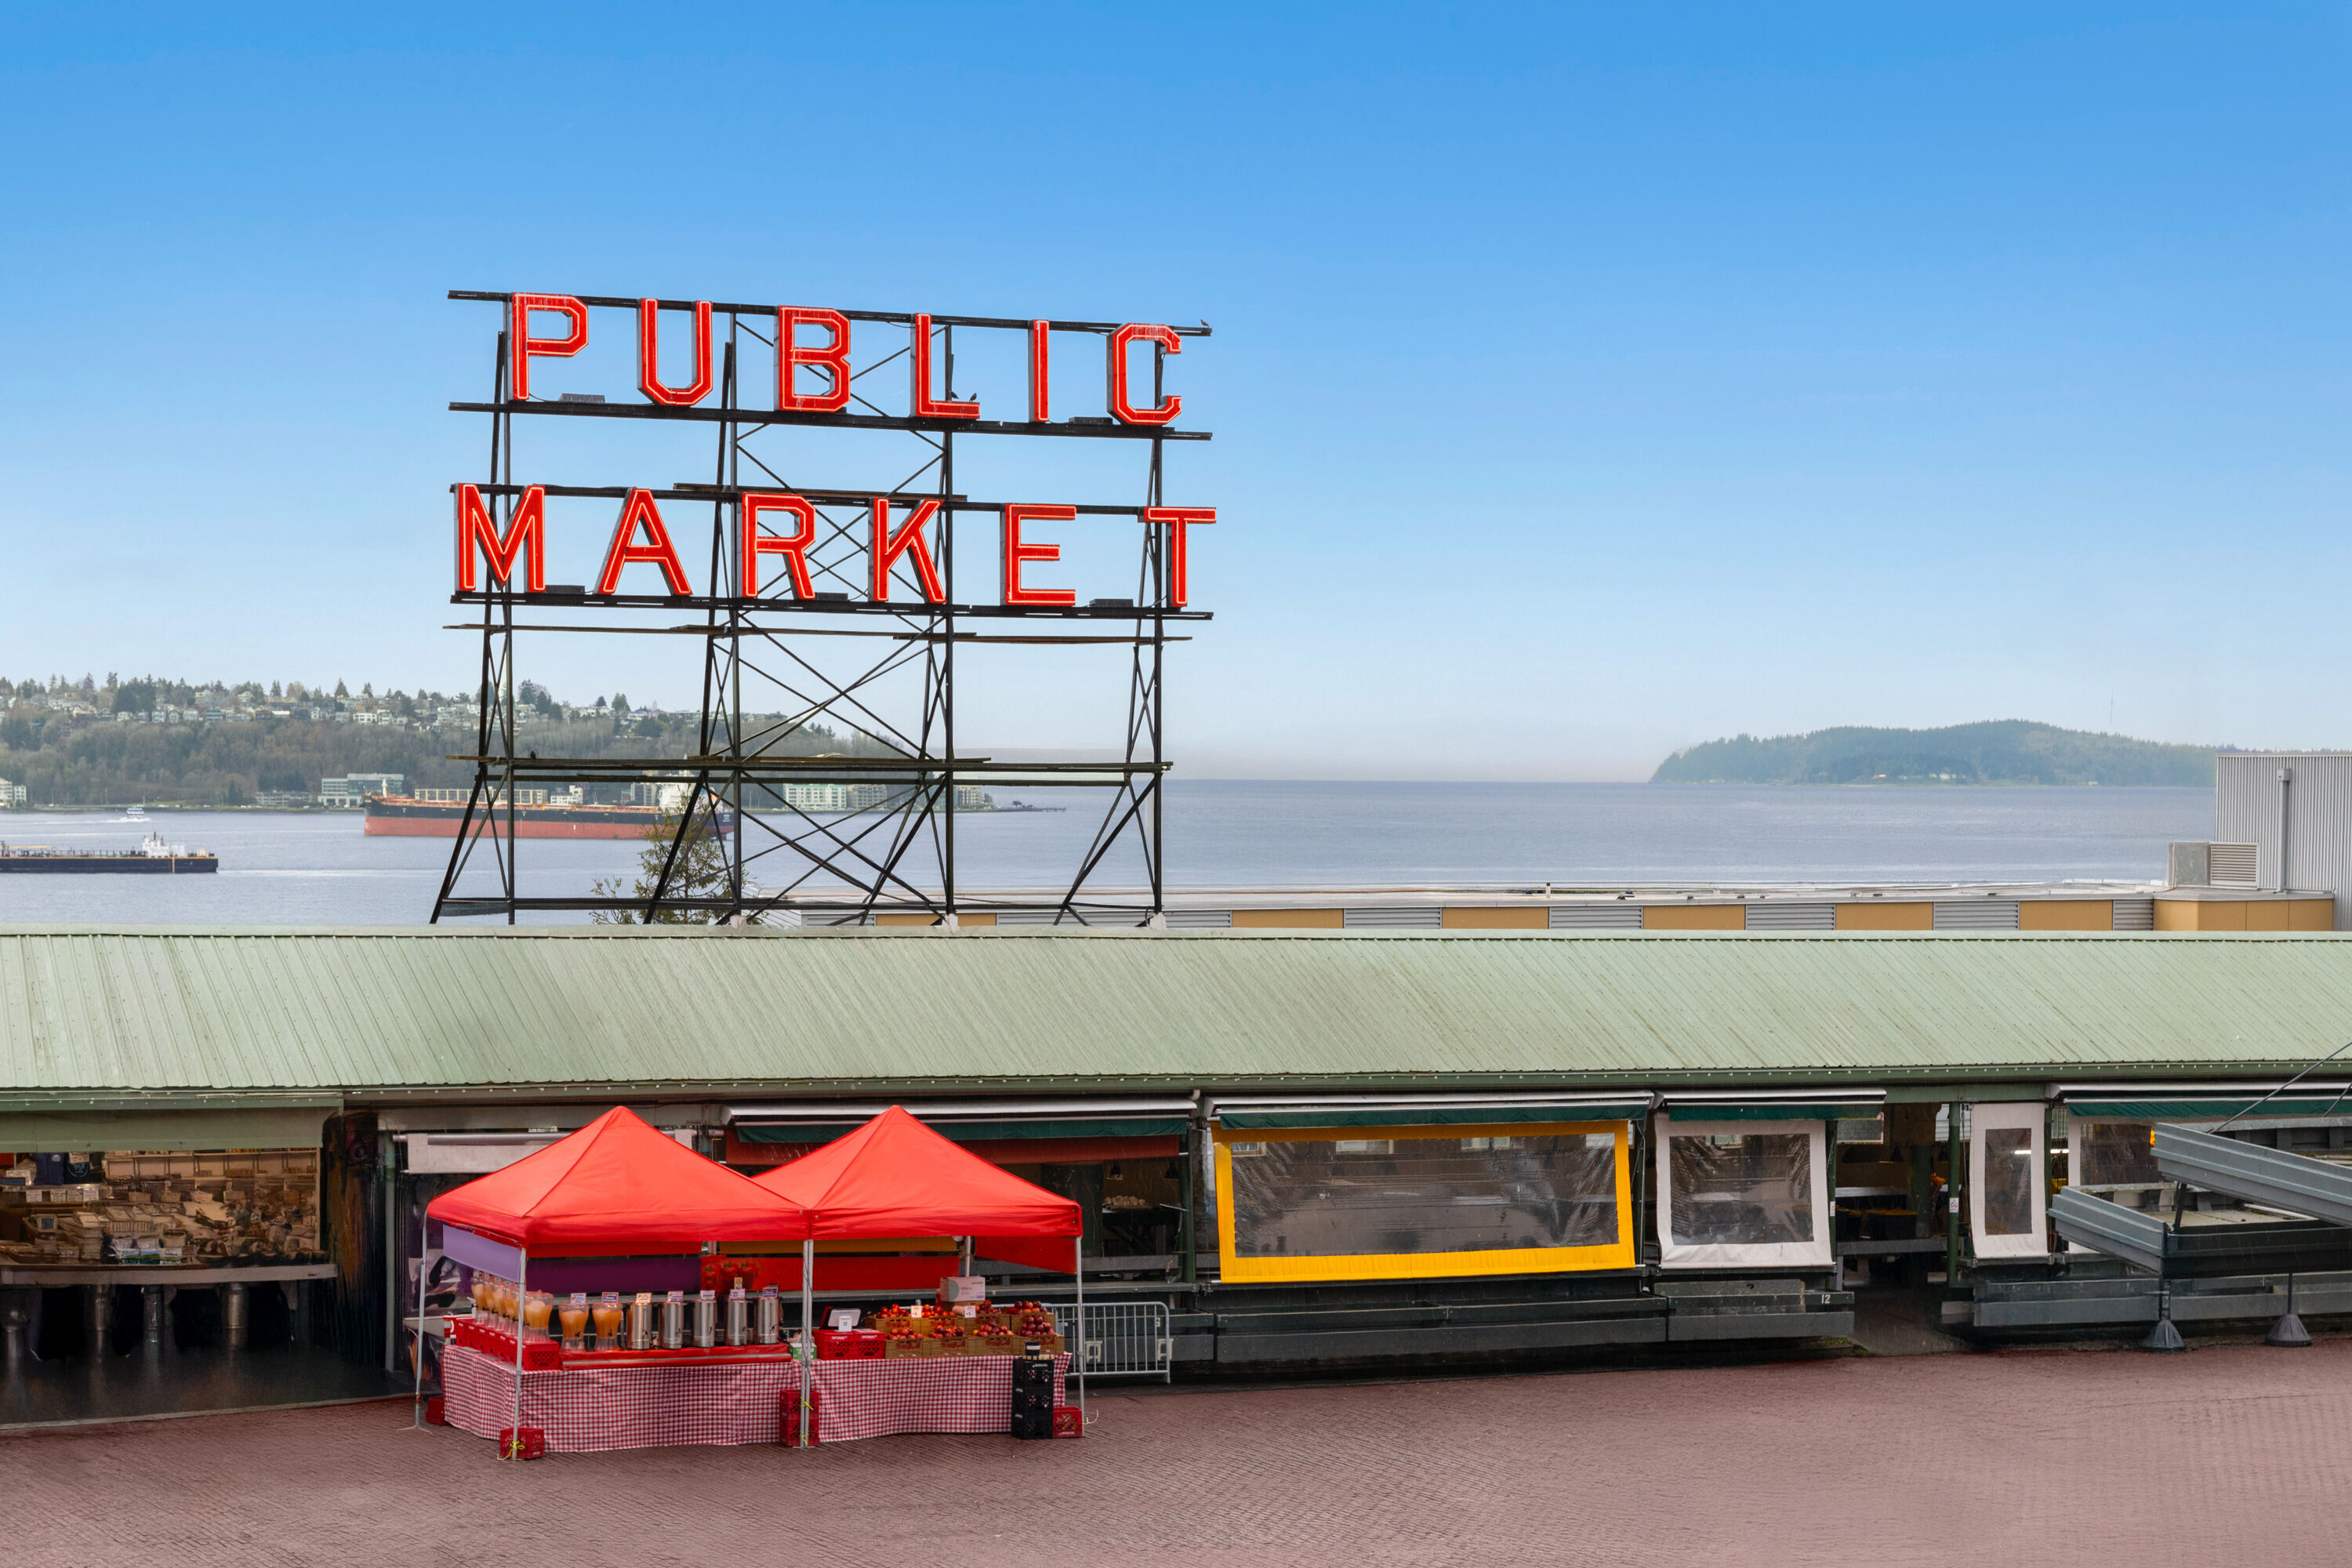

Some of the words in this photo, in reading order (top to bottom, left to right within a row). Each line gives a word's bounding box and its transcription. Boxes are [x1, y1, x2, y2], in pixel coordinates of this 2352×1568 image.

[510, 291, 1182, 427] PUBLIC
[455, 482, 1217, 608] MARKET
[1821, 1294, 1831, 1305] 12
